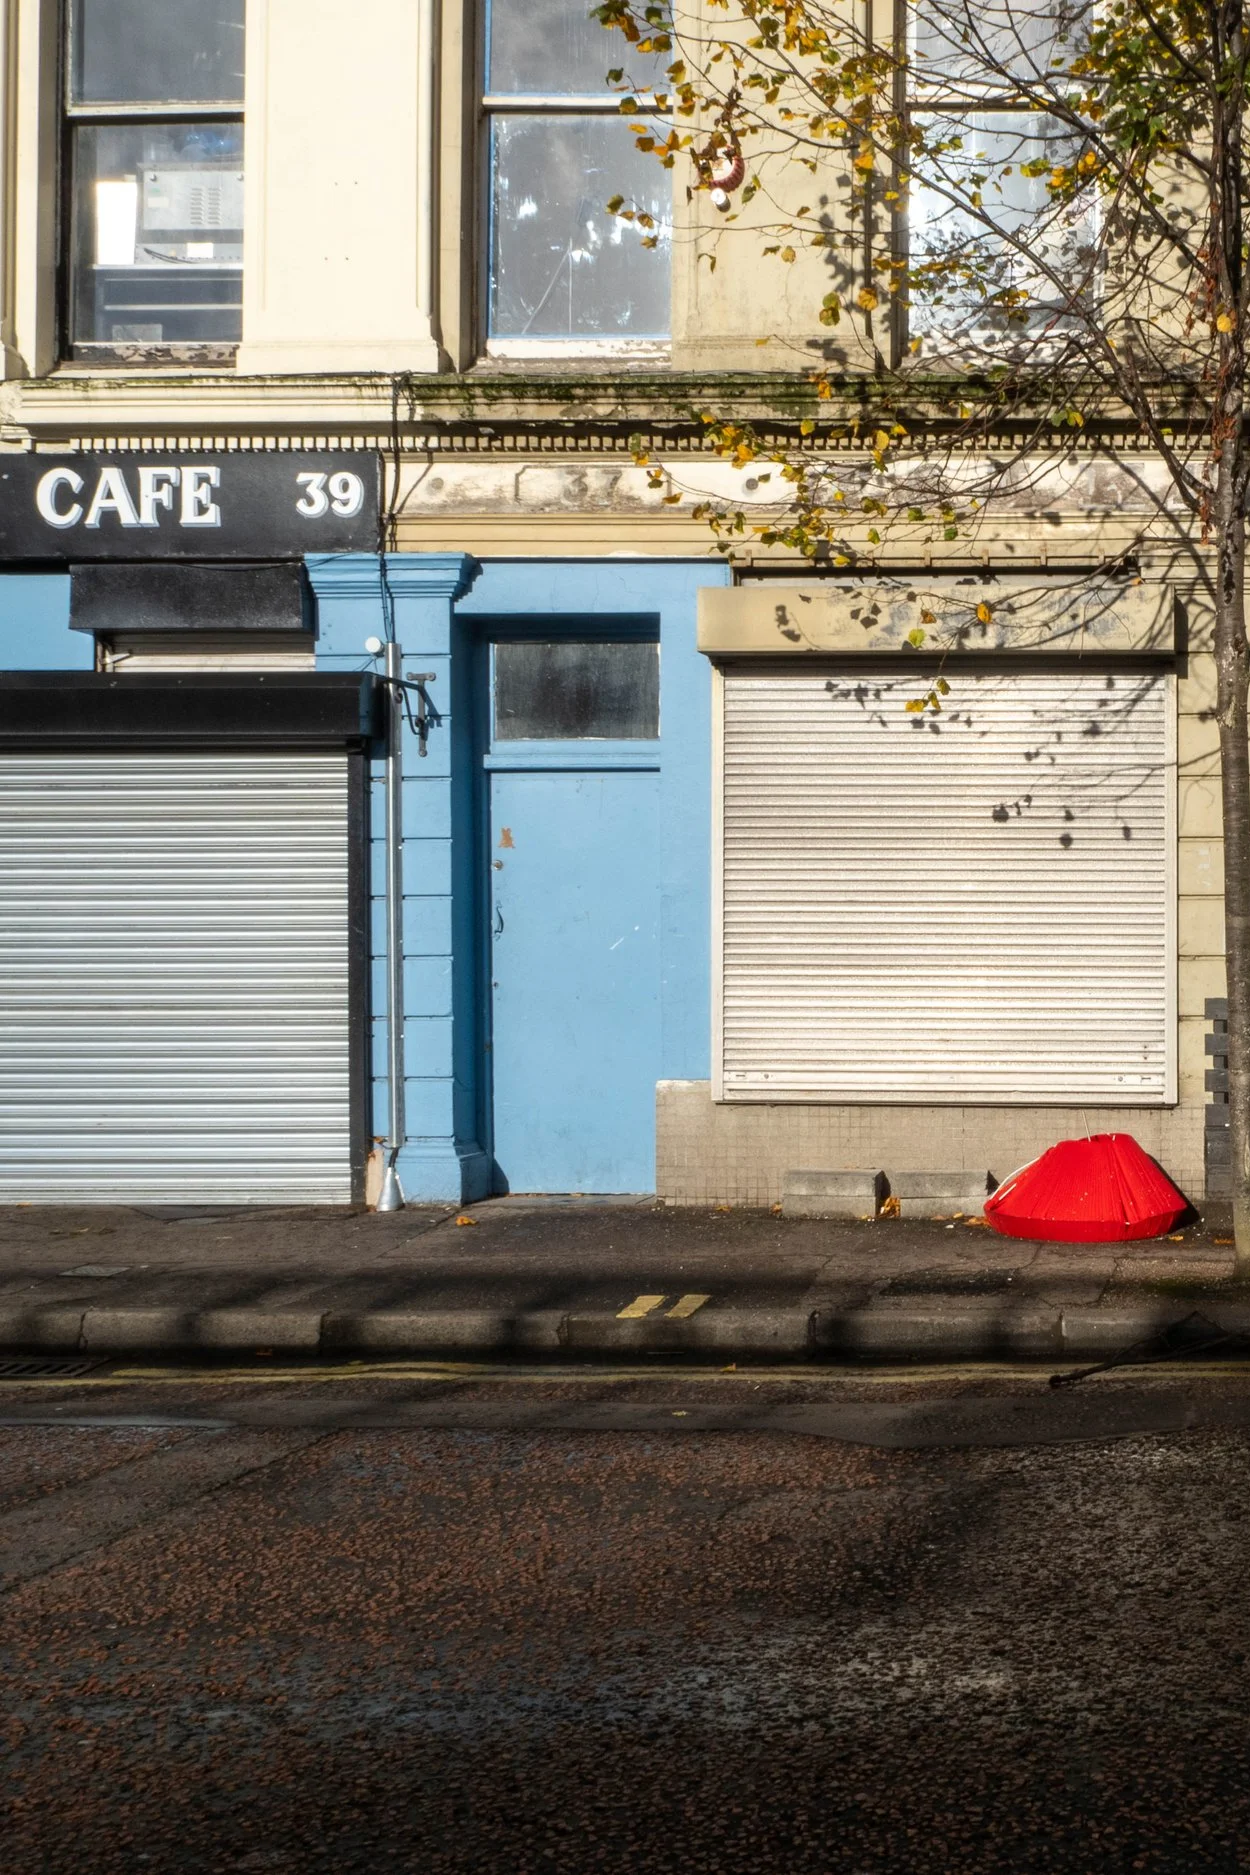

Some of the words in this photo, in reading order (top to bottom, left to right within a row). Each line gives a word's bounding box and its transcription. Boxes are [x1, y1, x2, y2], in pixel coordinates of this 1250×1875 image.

[36, 466, 222, 529] CAFE
[295, 471, 365, 518] 39
[563, 469, 622, 501] 37
